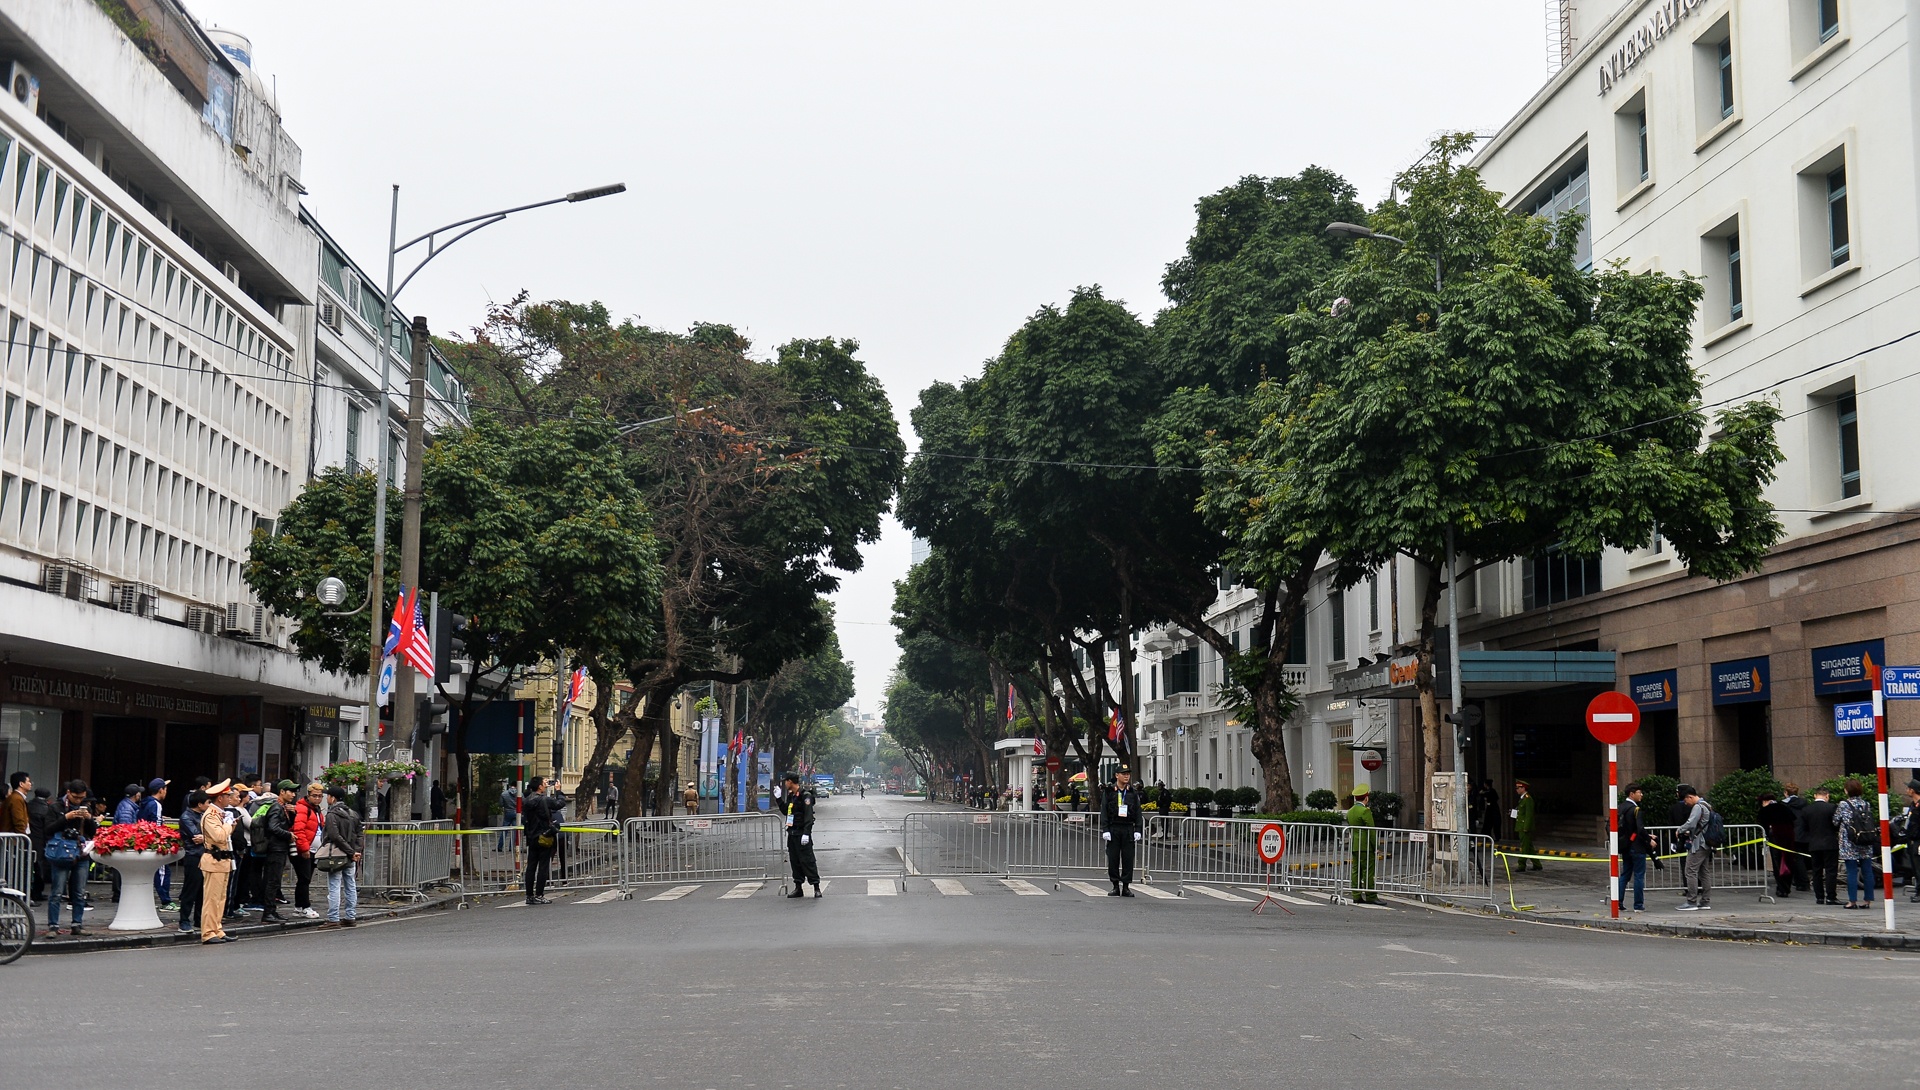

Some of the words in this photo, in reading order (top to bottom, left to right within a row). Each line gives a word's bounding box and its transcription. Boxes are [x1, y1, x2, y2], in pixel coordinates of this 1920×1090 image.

[1820, 656, 1860, 670] SINGAPORE
[1718, 671, 1750, 683] SINGAPORE
[1830, 666, 1861, 678] AIRLINES
[1636, 682, 1662, 694] SINGAPORE
[1725, 680, 1751, 691] AIRLINES
[1886, 680, 1918, 694] TRÀNG
[1642, 690, 1663, 700] AIRLINES
[135, 692, 174, 711] PAINTING
[176, 698, 219, 716] EXHIBITION
[1847, 706, 1861, 716] PHỐ
[1837, 716, 1851, 731] NGÔ
